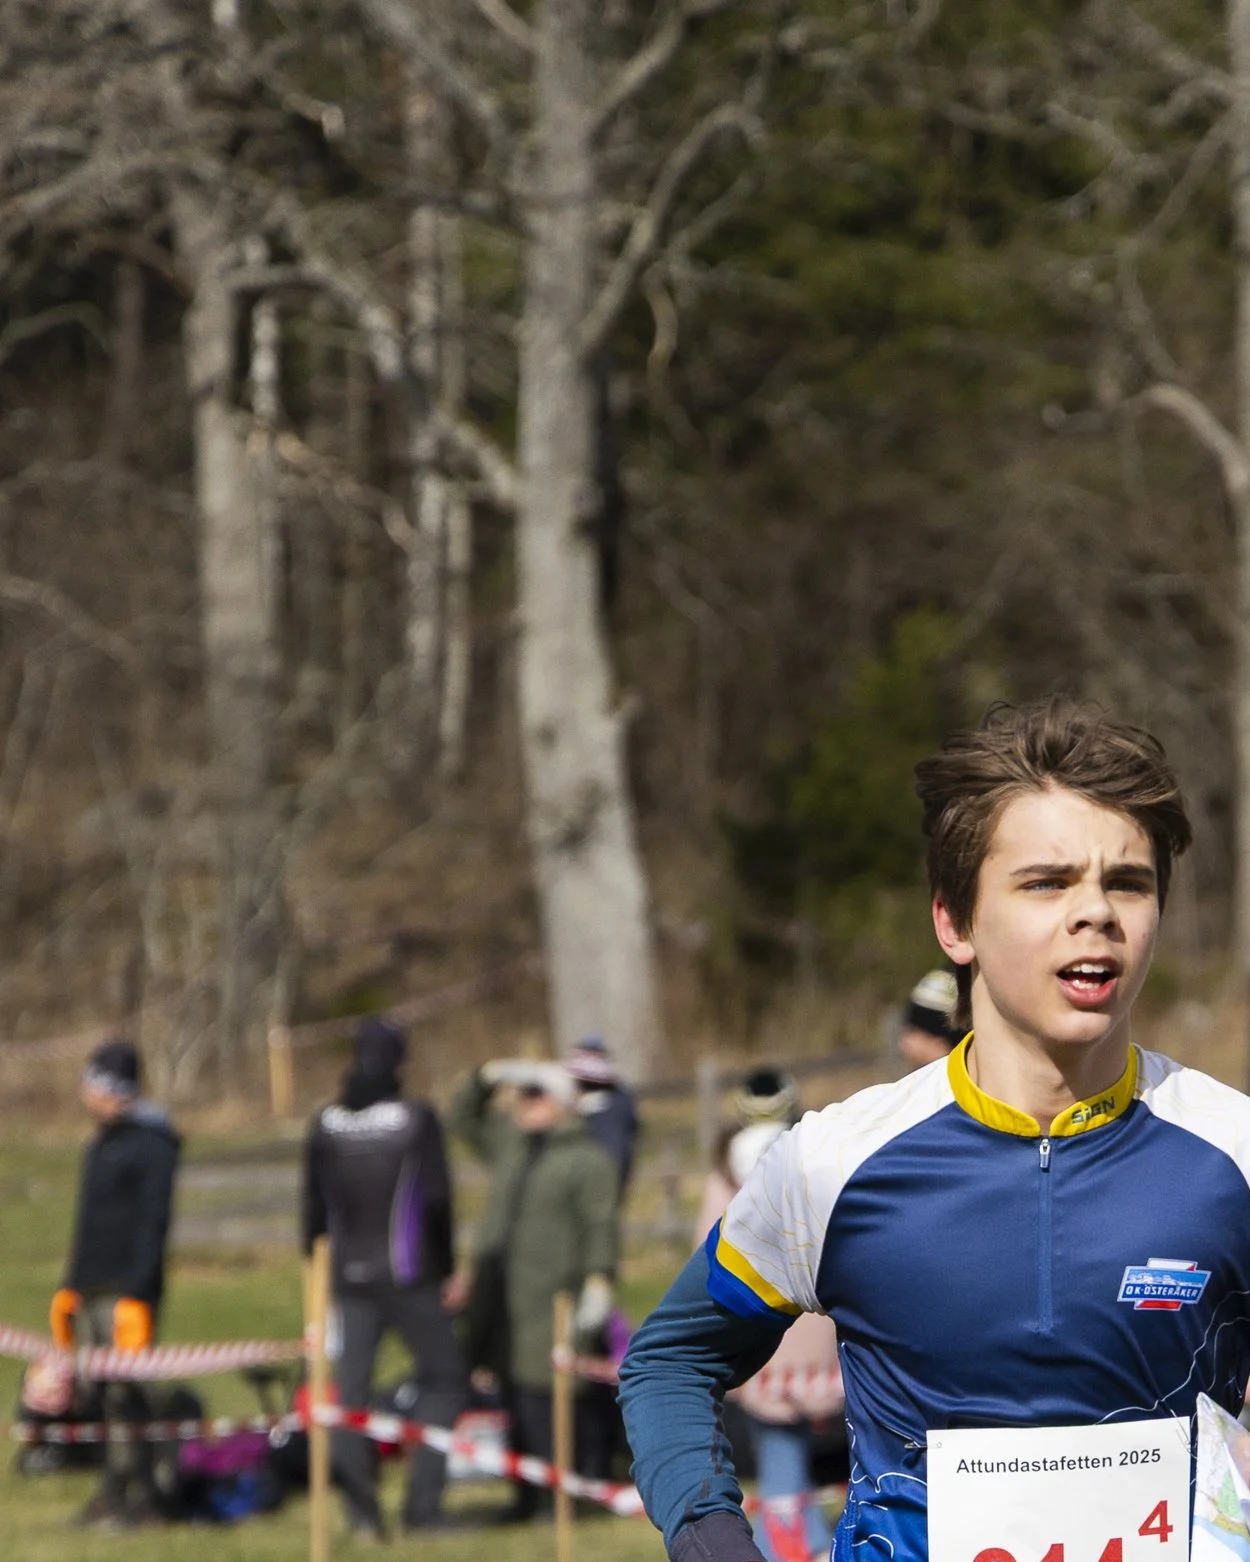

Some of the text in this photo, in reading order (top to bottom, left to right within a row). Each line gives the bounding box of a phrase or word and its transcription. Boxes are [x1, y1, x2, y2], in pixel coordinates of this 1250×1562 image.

[956, 1448, 1161, 1474] Attundastafetten 2025
[1138, 1500, 1173, 1543] 4
